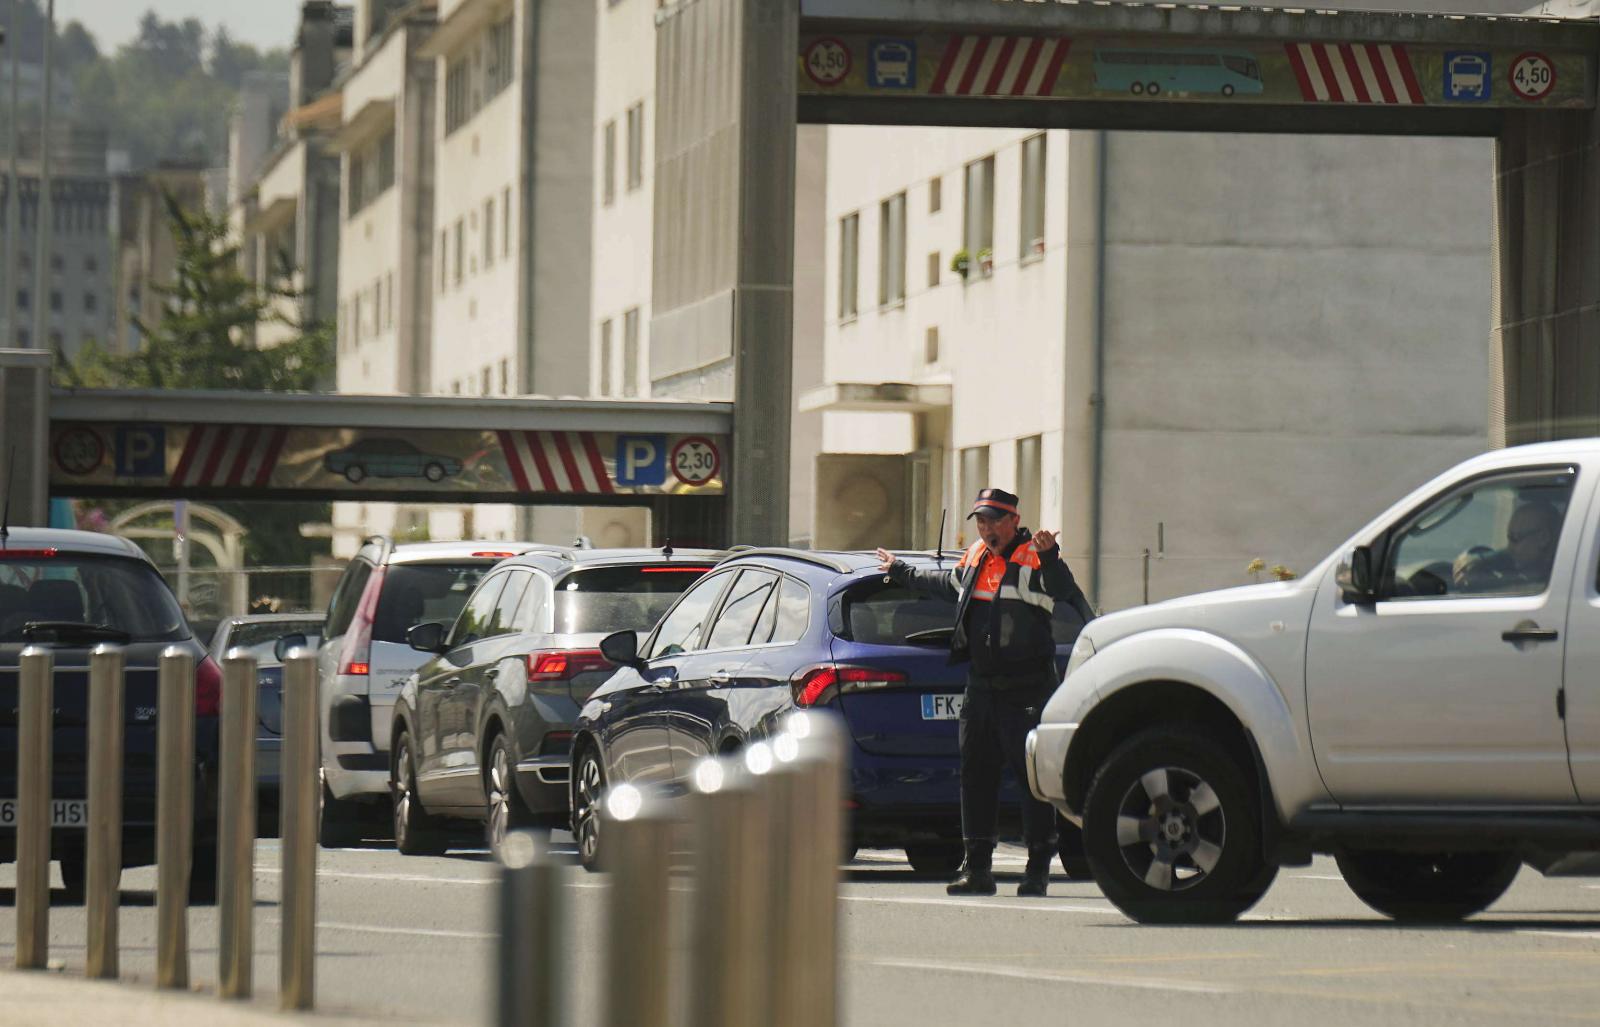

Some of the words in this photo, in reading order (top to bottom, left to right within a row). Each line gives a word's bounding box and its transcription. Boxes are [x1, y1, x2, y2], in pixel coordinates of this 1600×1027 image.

[811, 52, 845, 71] 4,50
[1515, 67, 1550, 86] 4,50
[125, 432, 156, 473] P
[626, 440, 656, 480] P
[678, 452, 714, 472] 2,30
